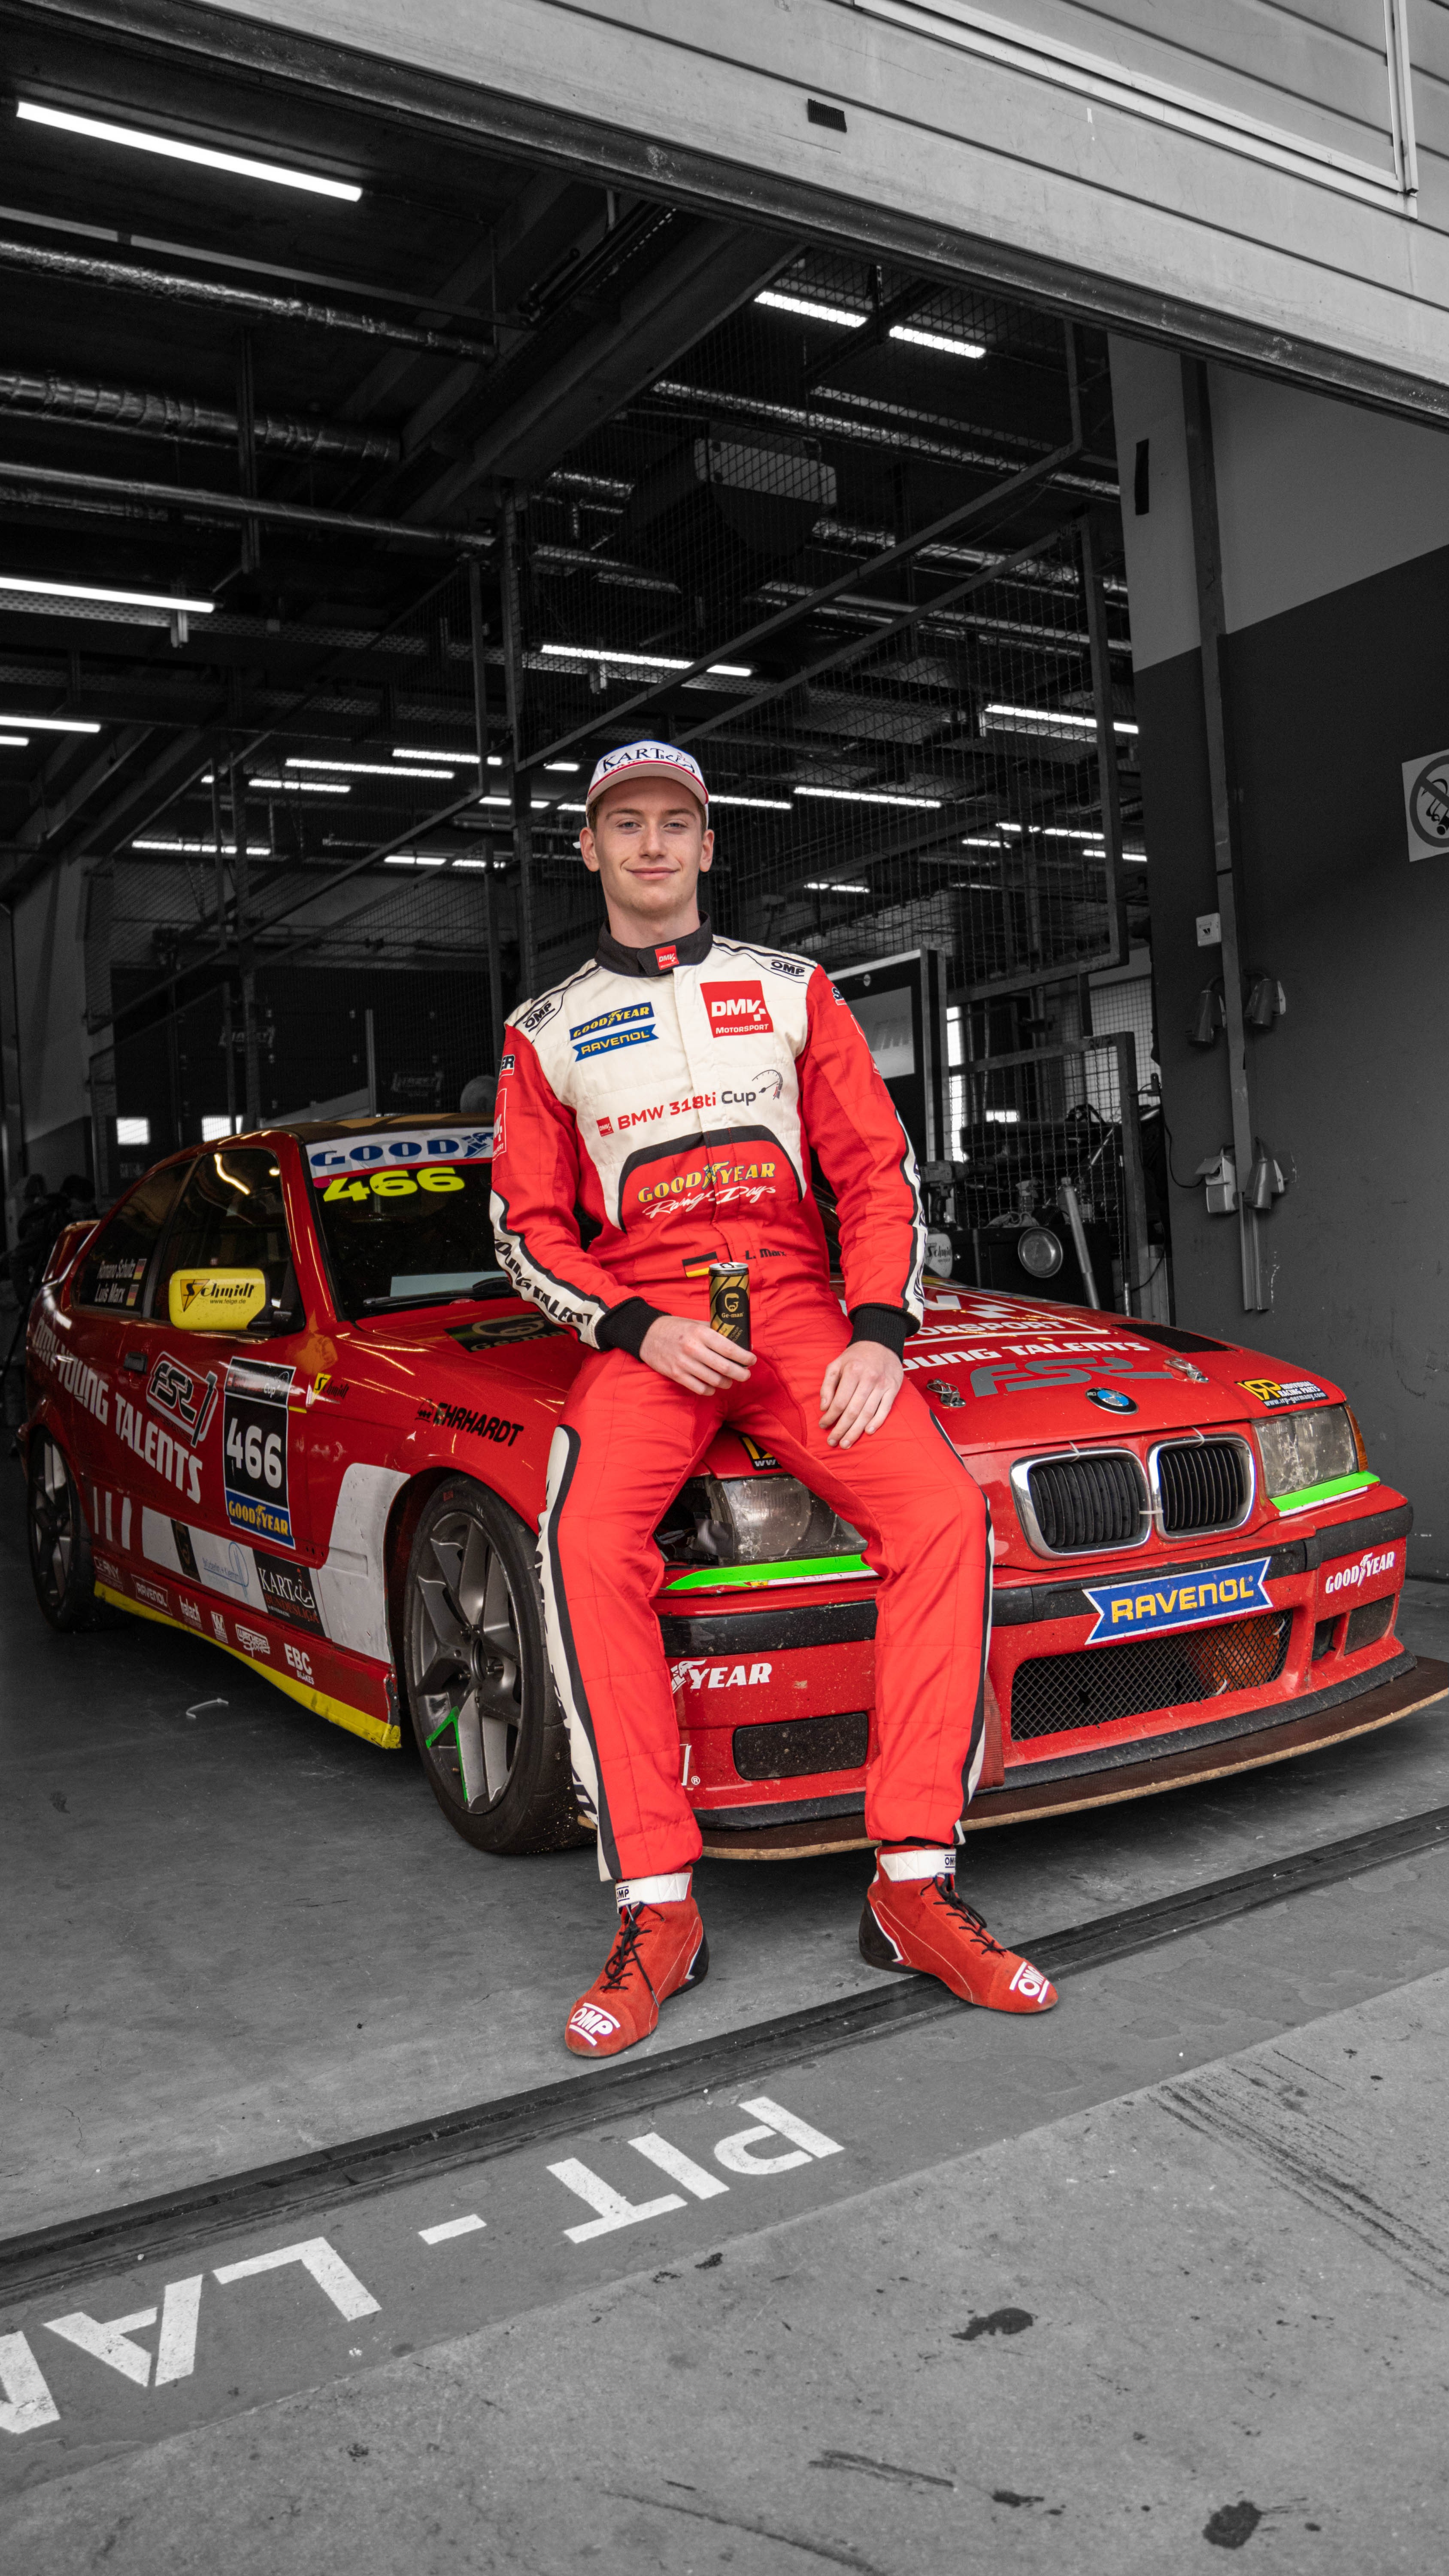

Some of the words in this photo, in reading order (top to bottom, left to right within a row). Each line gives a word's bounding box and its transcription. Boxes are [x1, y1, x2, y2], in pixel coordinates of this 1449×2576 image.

[603, 748, 664, 773] KART
[659, 953, 675, 963] DMV
[772, 961, 805, 975] OMP
[524, 1002, 552, 1028] OMP
[711, 999, 761, 1017] DMV
[715, 1024, 769, 1034] MOTORSPORT
[581, 1031, 650, 1054] RAVENOL
[618, 1105, 664, 1130] BMW
[670, 1092, 716, 1115] 318ti
[721, 1091, 756, 1106] Cup
[310, 1139, 459, 1166] GOOD
[323, 1167, 465, 1202] 466
[638, 1162, 776, 1202] GOODYEAR
[710, 1185, 776, 1204] Days
[495, 1239, 531, 1291] OUNG
[746, 1250, 756, 1260] L.
[94, 1283, 108, 1302] Luis
[183, 1282, 254, 1298] Schmidt
[917, 1321, 1066, 1335] ORSPORT
[1001, 1343, 1150, 1355] TALENTS
[264, 1383, 276, 1397] Cup
[1264, 1392, 1326, 1406] www.irp-germany.com
[1277, 1387, 1302, 1397] RACING
[1301, 1386, 1321, 1394] PARTS
[58, 1346, 109, 1426] YOUNG
[115, 1392, 203, 1504] TALENTS
[433, 1402, 524, 1446] EHRHARDT
[227, 1418, 282, 1488] 466
[229, 1501, 288, 1536] GOODYEAR
[258, 1567, 293, 1601] KART
[1326, 1552, 1395, 1594] GOODYEAR
[136, 1582, 167, 1607] RAVENOL
[1111, 1578, 1255, 1623] RAVENOL
[265, 1592, 320, 1624] BUNDESLIGA
[284, 1643, 312, 1675] EBC
[297, 1670, 314, 1685] BRAKES
[688, 1662, 772, 1690] YEAR
[945, 1857, 955, 1865] OM
[570, 2008, 613, 2035] OMP
[546, 2096, 845, 2244] PIT
